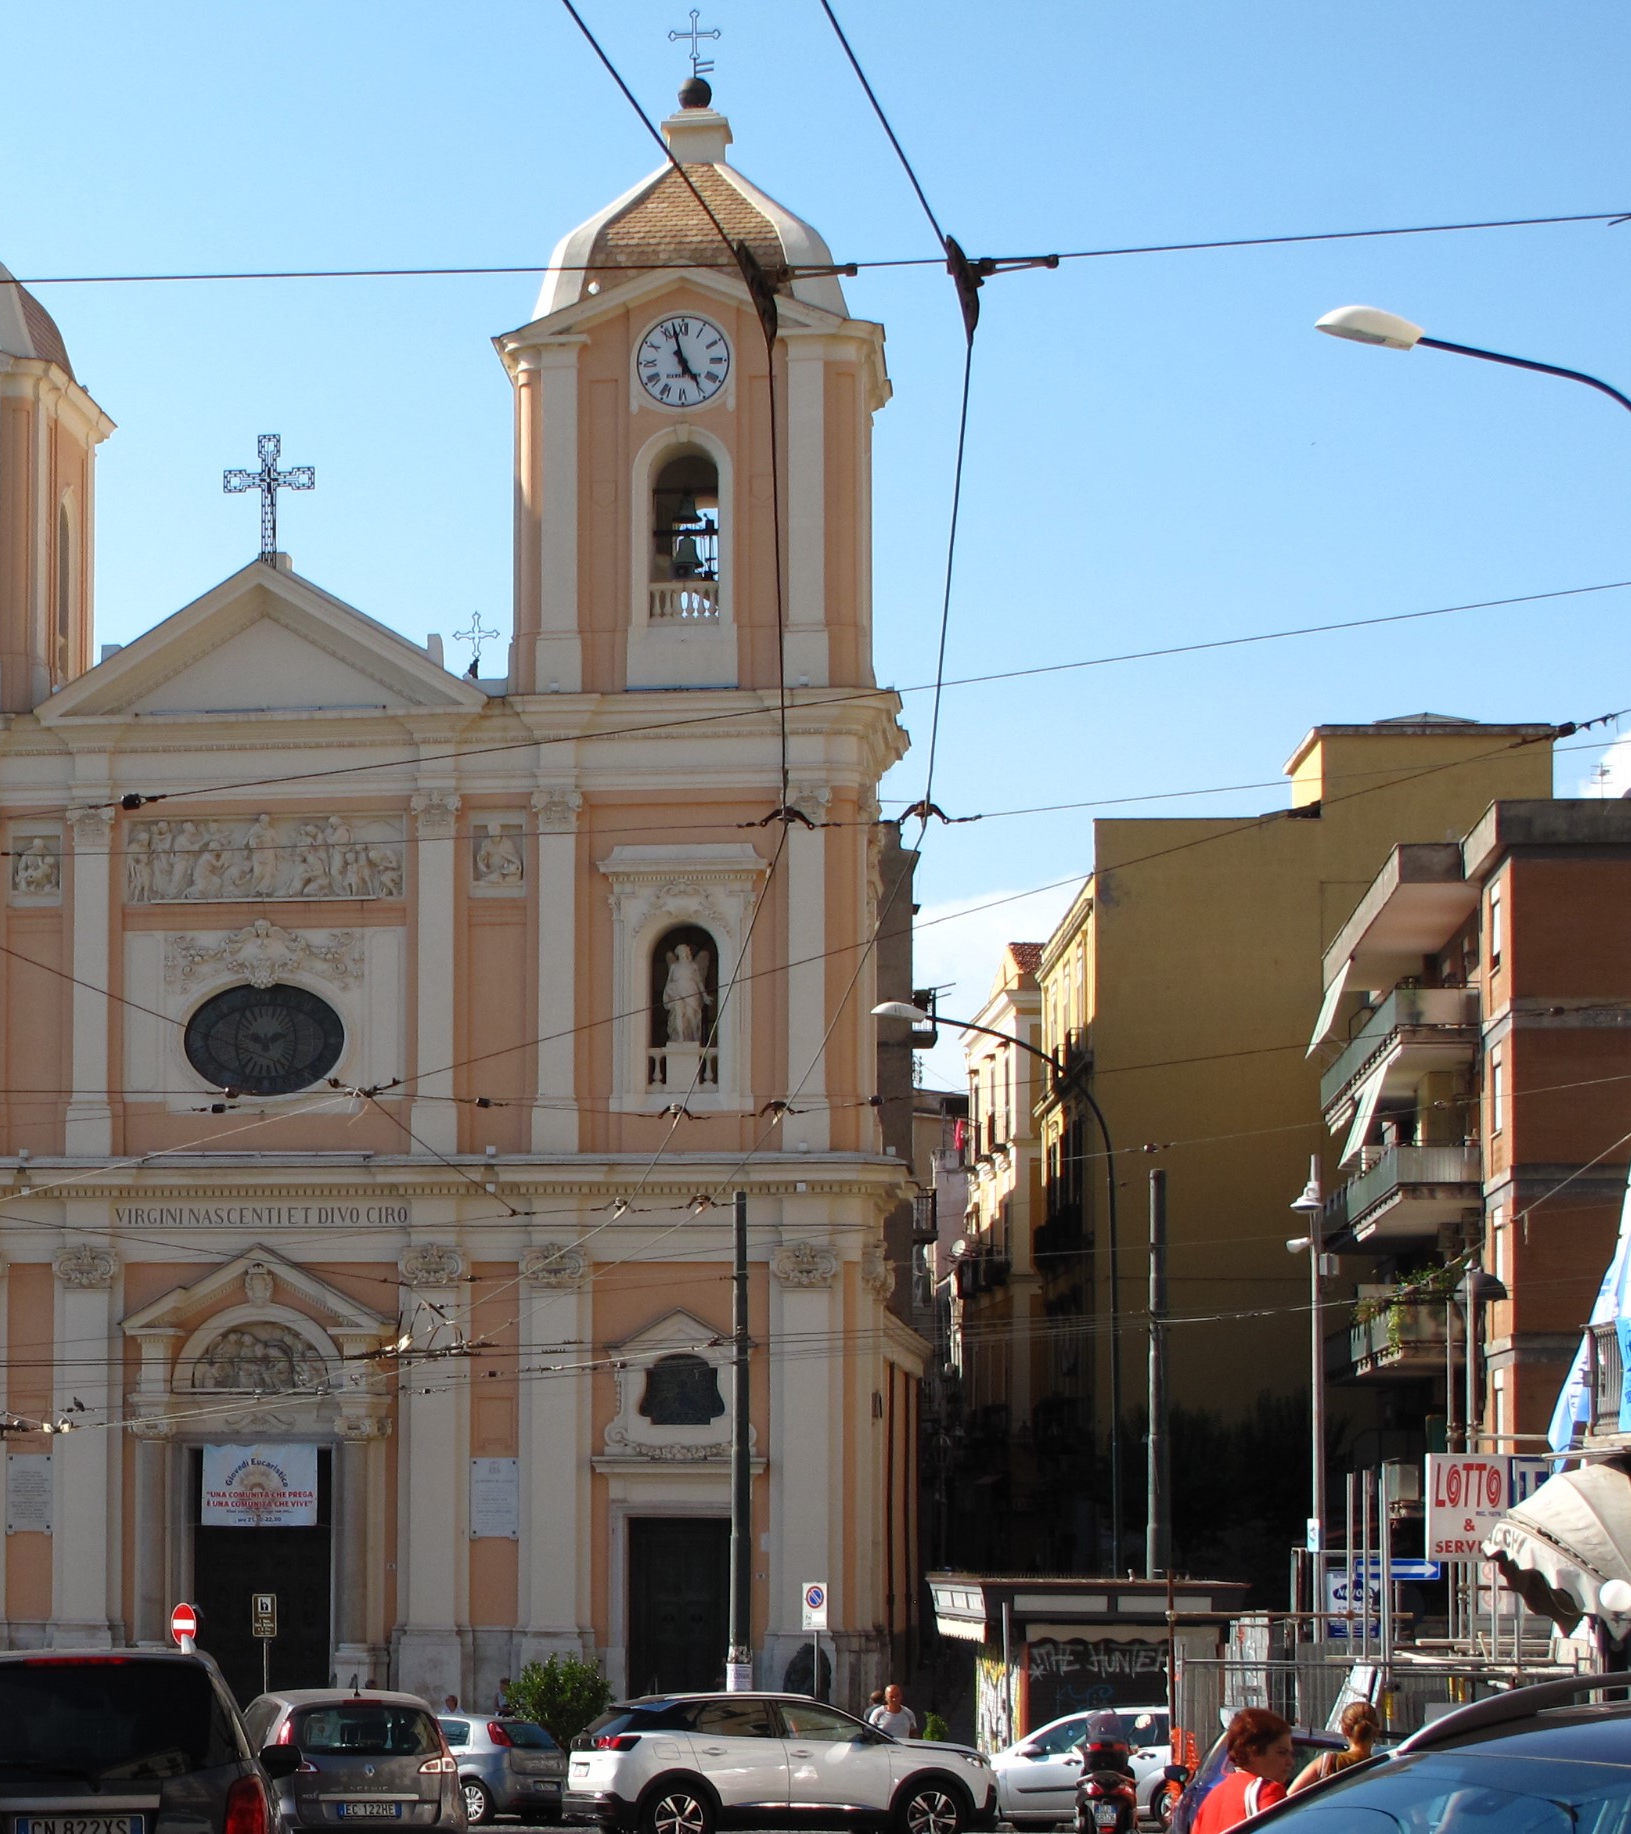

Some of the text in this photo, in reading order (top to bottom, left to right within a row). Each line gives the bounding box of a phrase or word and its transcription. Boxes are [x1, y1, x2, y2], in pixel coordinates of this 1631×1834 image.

[115, 1206, 408, 1225] VIRGINI NASCENTI ET DIVO CIRO
[251, 1457, 289, 1488] Eucaristico
[1435, 1462, 1502, 1508] LOTTO
[1463, 1518, 1476, 1532] &
[1435, 1540, 1482, 1554] SERVI
[346, 1803, 394, 1815] EC 122HE
